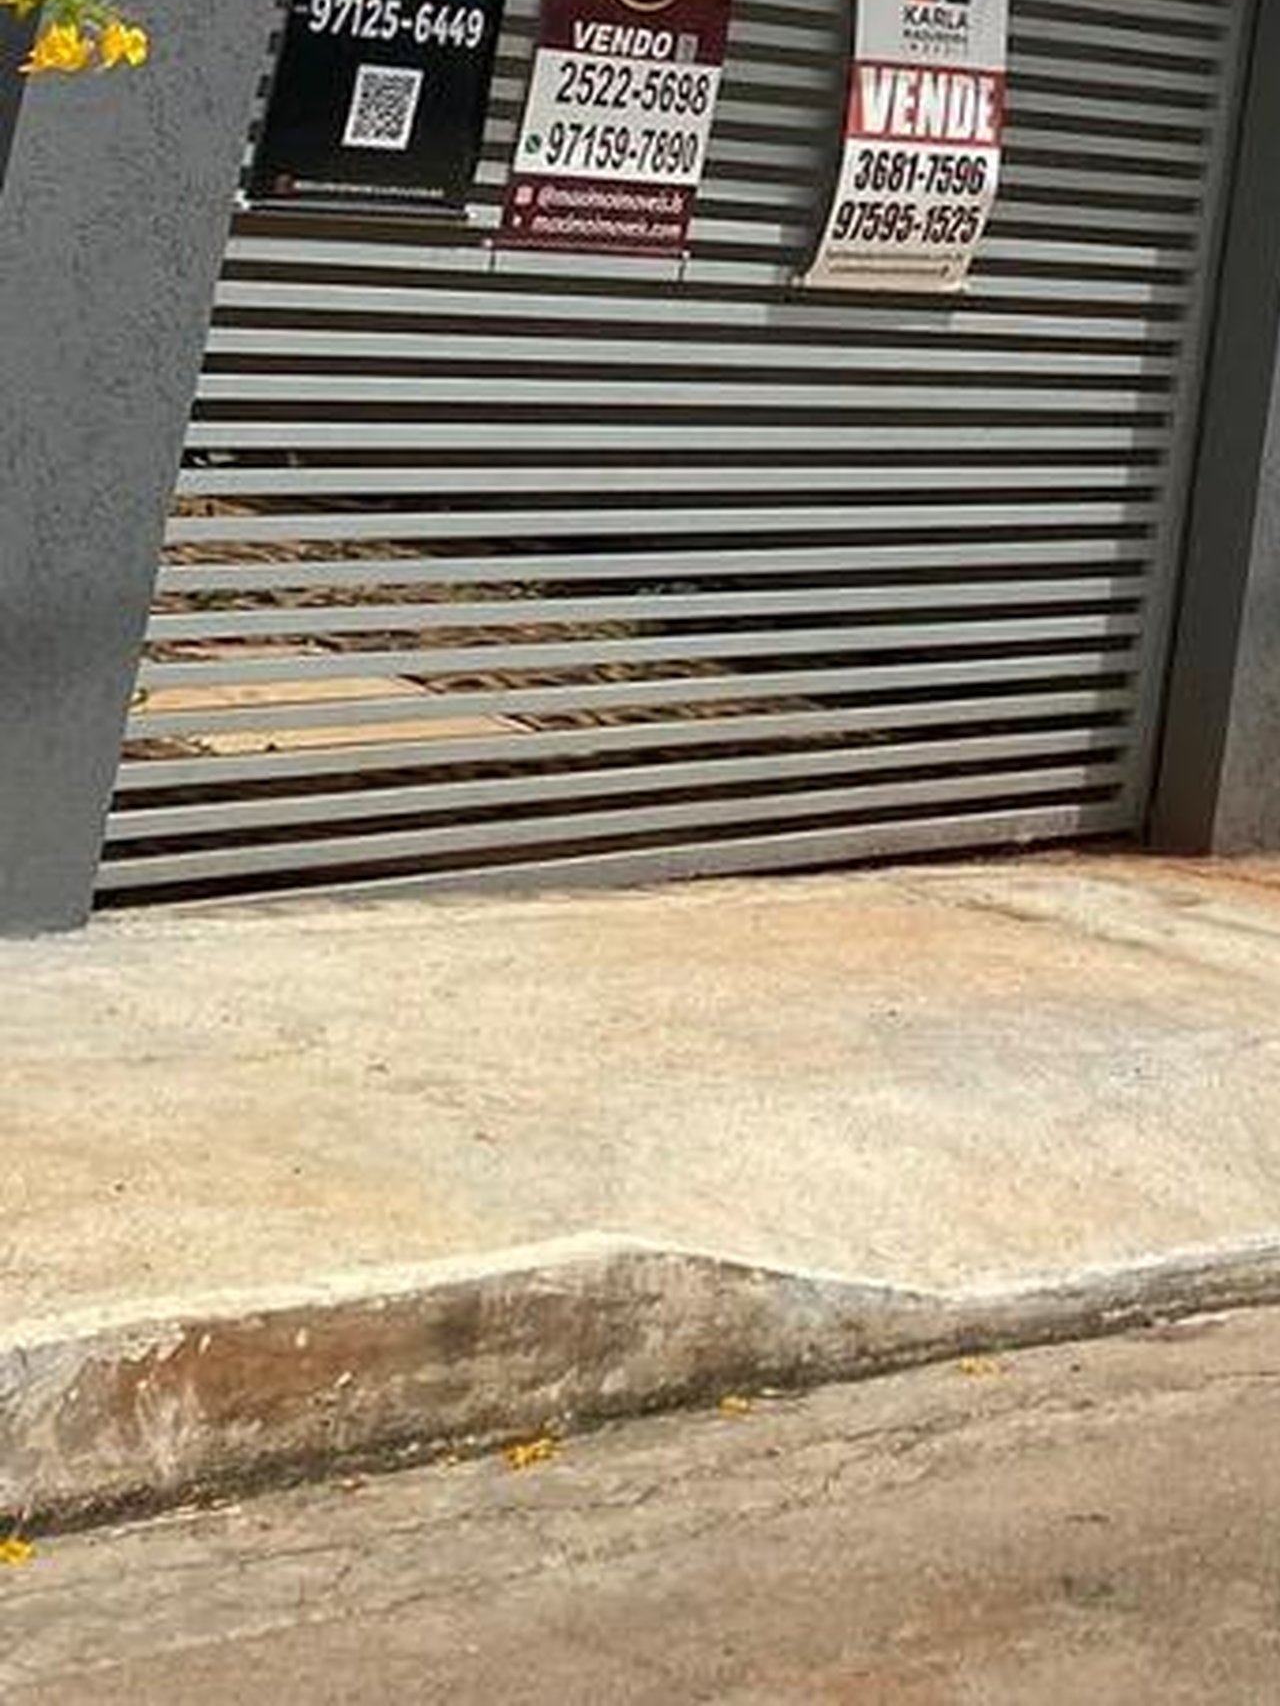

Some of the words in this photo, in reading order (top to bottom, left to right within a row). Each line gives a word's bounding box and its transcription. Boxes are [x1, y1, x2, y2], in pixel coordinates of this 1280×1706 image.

[573, 20, 673, 60] VENDO
[902, 5, 968, 30] KARLA
[556, 61, 710, 115] 2522-5698
[859, 65, 996, 141] VENDE
[546, 122, 698, 174] 97159-7890
[854, 149, 988, 195] 3681-7596
[832, 201, 982, 245] 97595-1525
